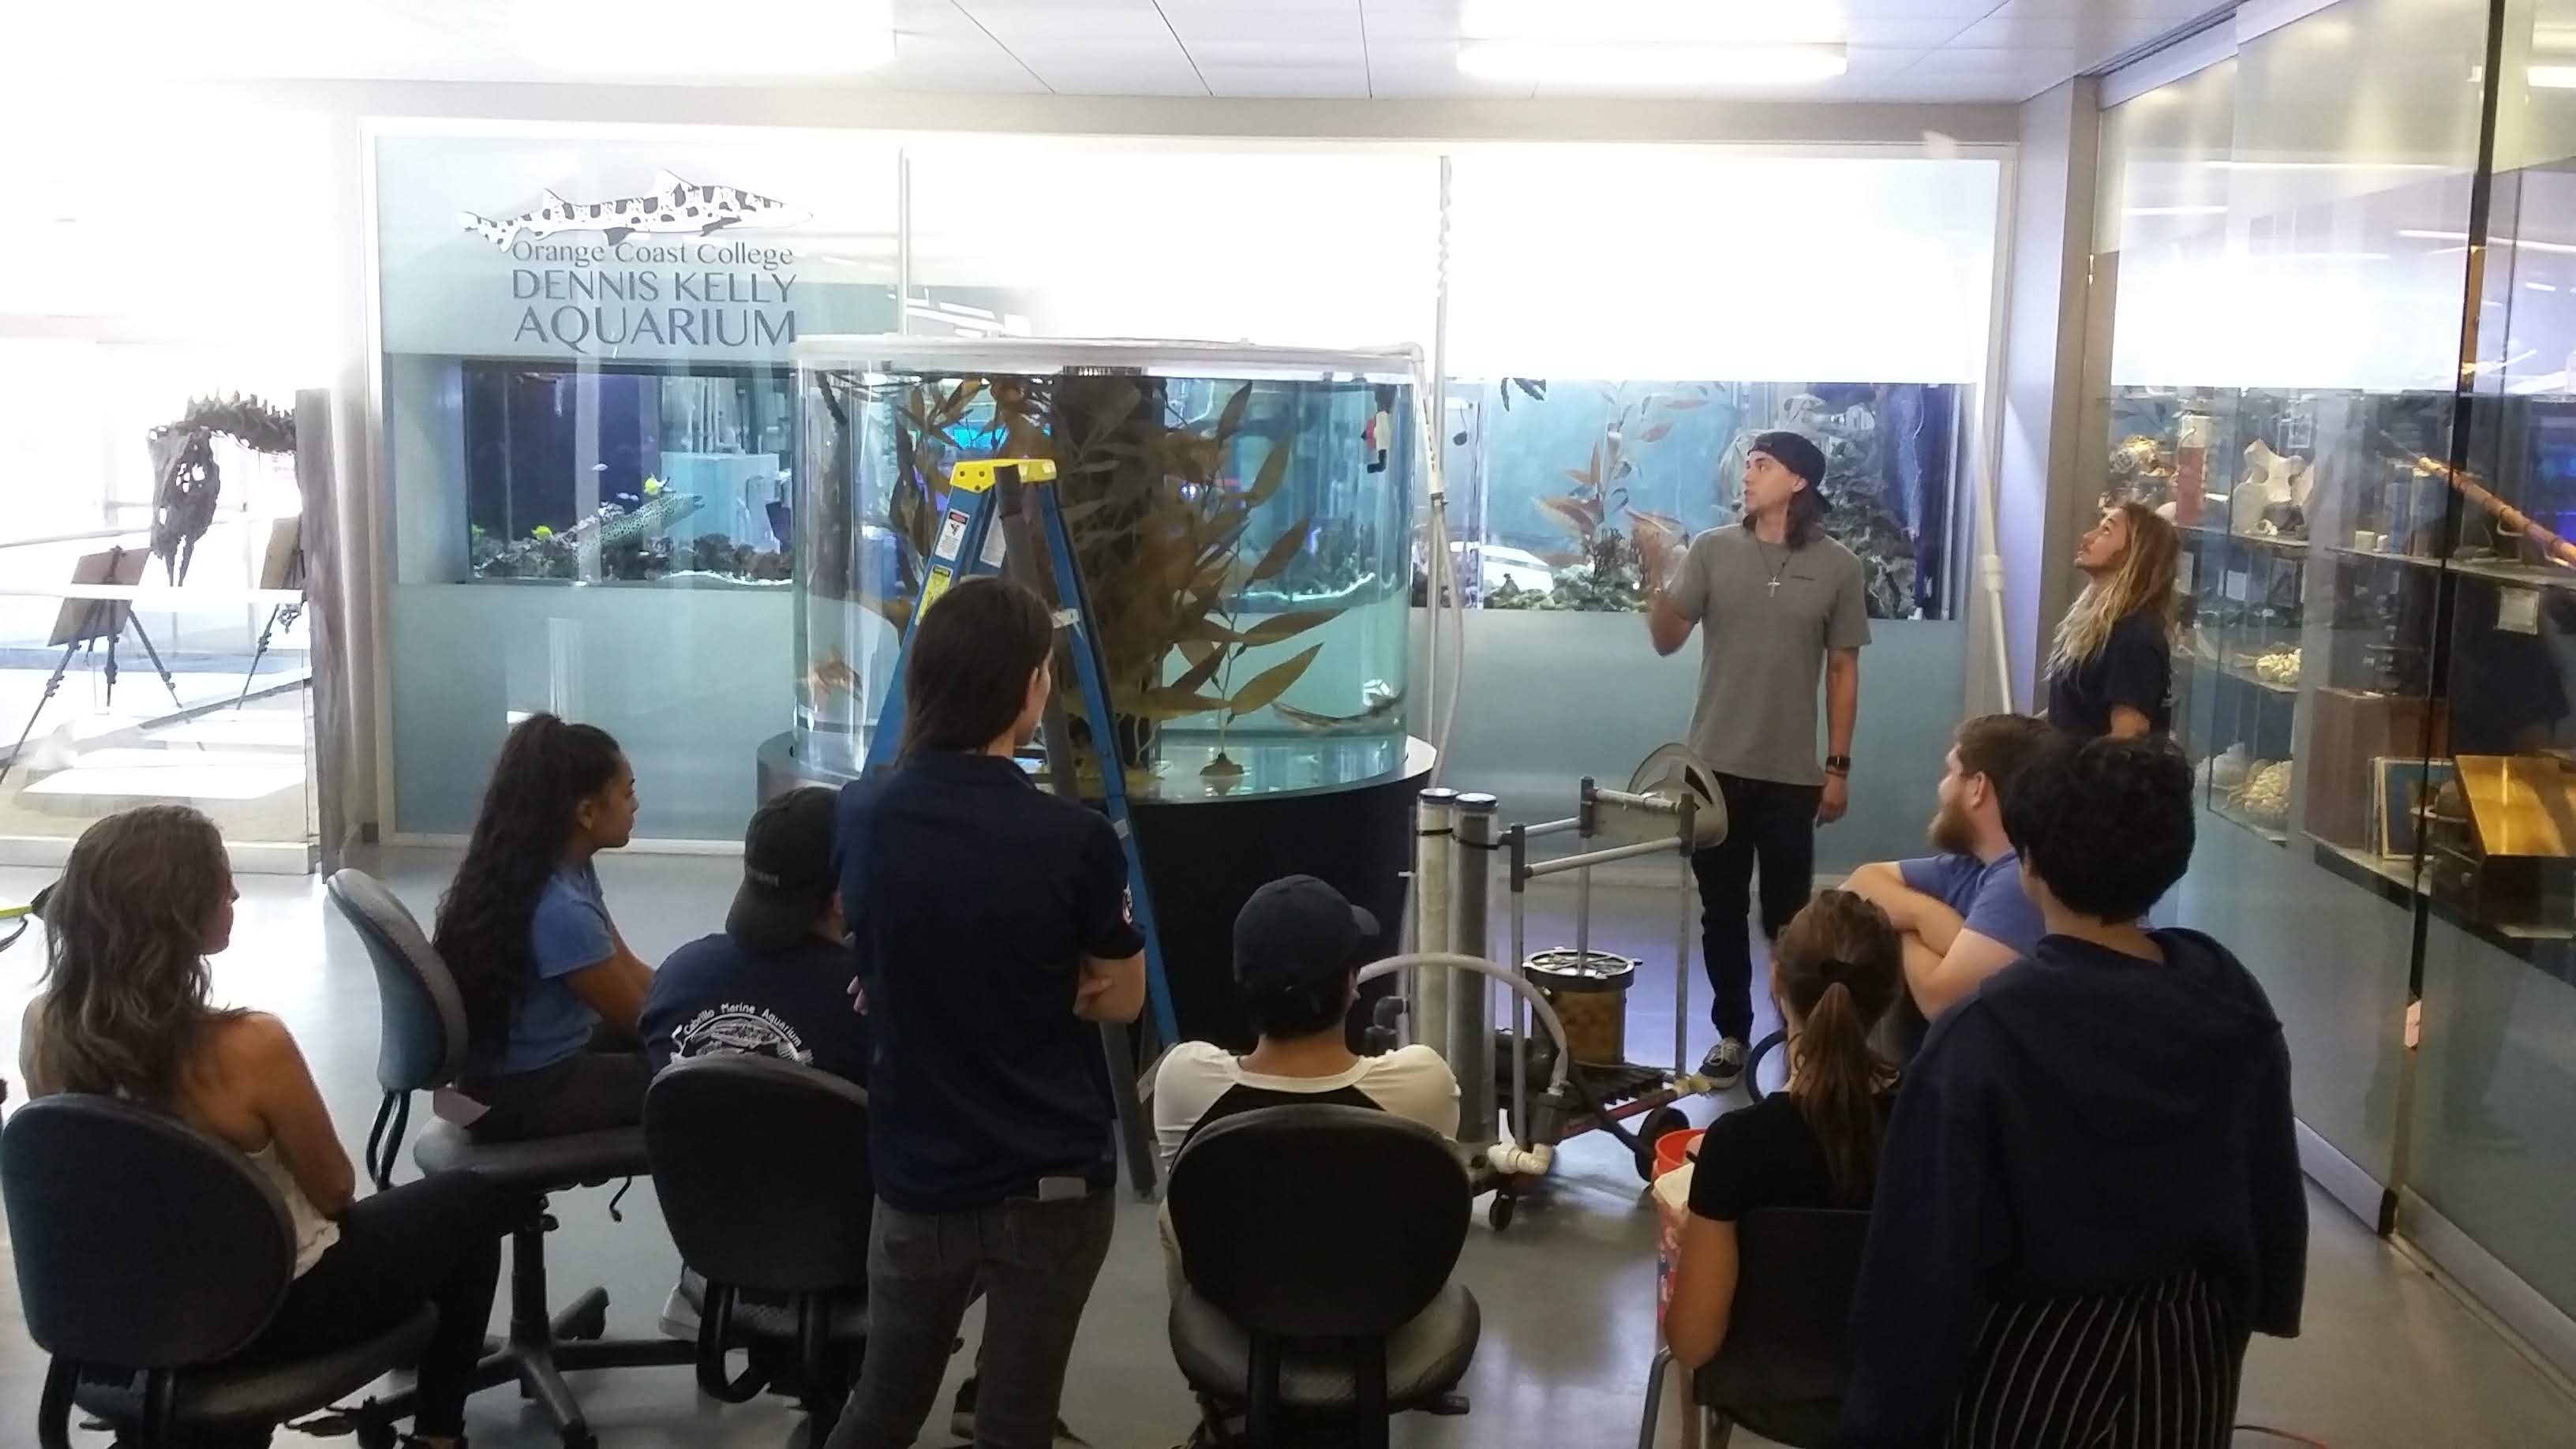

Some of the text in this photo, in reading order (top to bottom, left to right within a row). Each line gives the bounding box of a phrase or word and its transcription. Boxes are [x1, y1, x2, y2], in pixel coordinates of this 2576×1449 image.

[512, 241, 794, 271] Orange Coast College
[511, 268, 797, 303] DENNIS KELLY
[514, 305, 796, 354] AQUARIUM
[683, 1002, 803, 1047] Cabrillo Marine Aquarium
